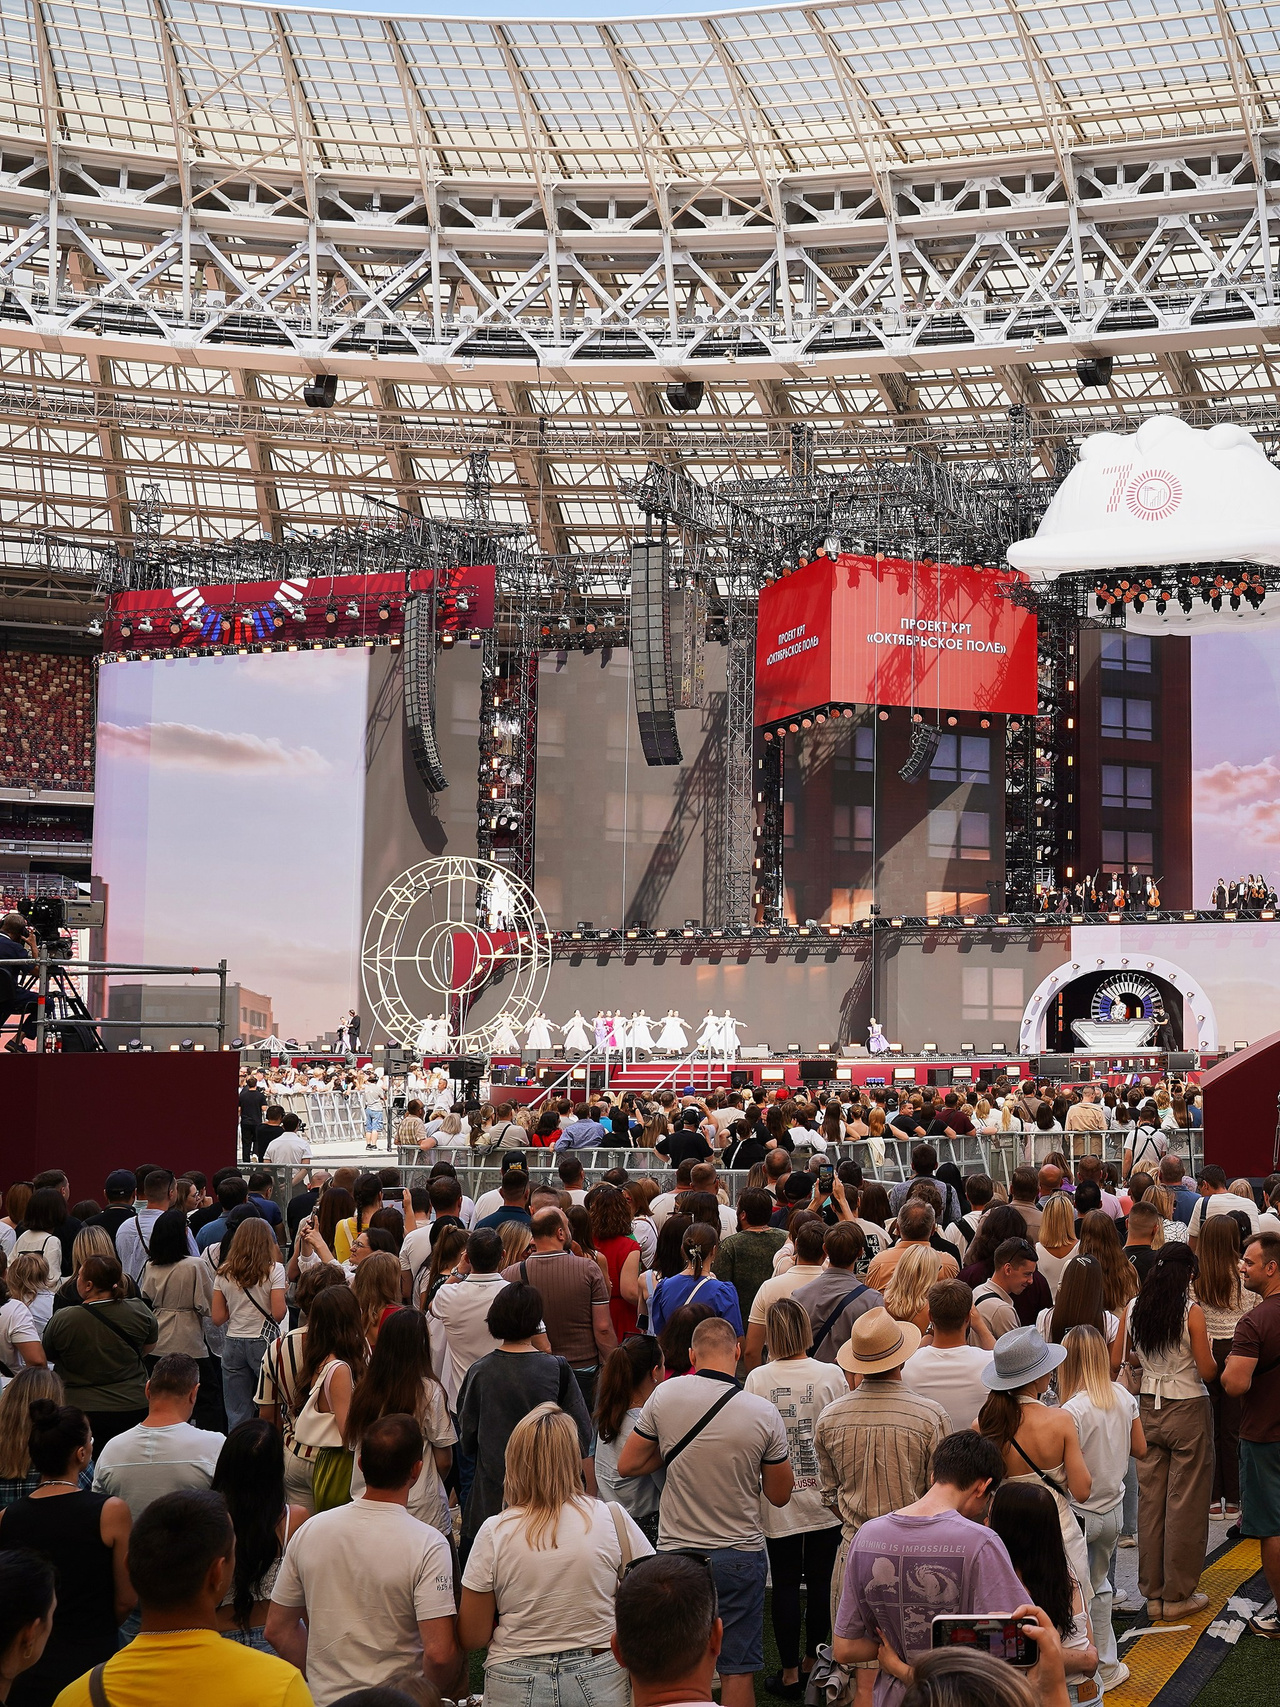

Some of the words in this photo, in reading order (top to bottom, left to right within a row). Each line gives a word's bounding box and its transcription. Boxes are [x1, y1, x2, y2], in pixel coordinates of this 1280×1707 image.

[778, 628, 796, 645] ПРОЕКТ
[797, 624, 806, 637] КРТ
[901, 618, 947, 633] ПРОЕКТ
[951, 622, 972, 635] КРТ
[767, 642, 802, 666] «ОКТЯБРЬСКОЕ
[802, 635, 819, 651] ПОЛЕ»
[867, 632, 963, 650] «ОКТЯБРЬСКОЕ
[966, 640, 1007, 654] ПОЛЕ»
[857, 1540, 887, 1550] NOTHING
[889, 1543, 899, 1551] IS
[901, 1544, 966, 1553] IMPOSSIBLE!
